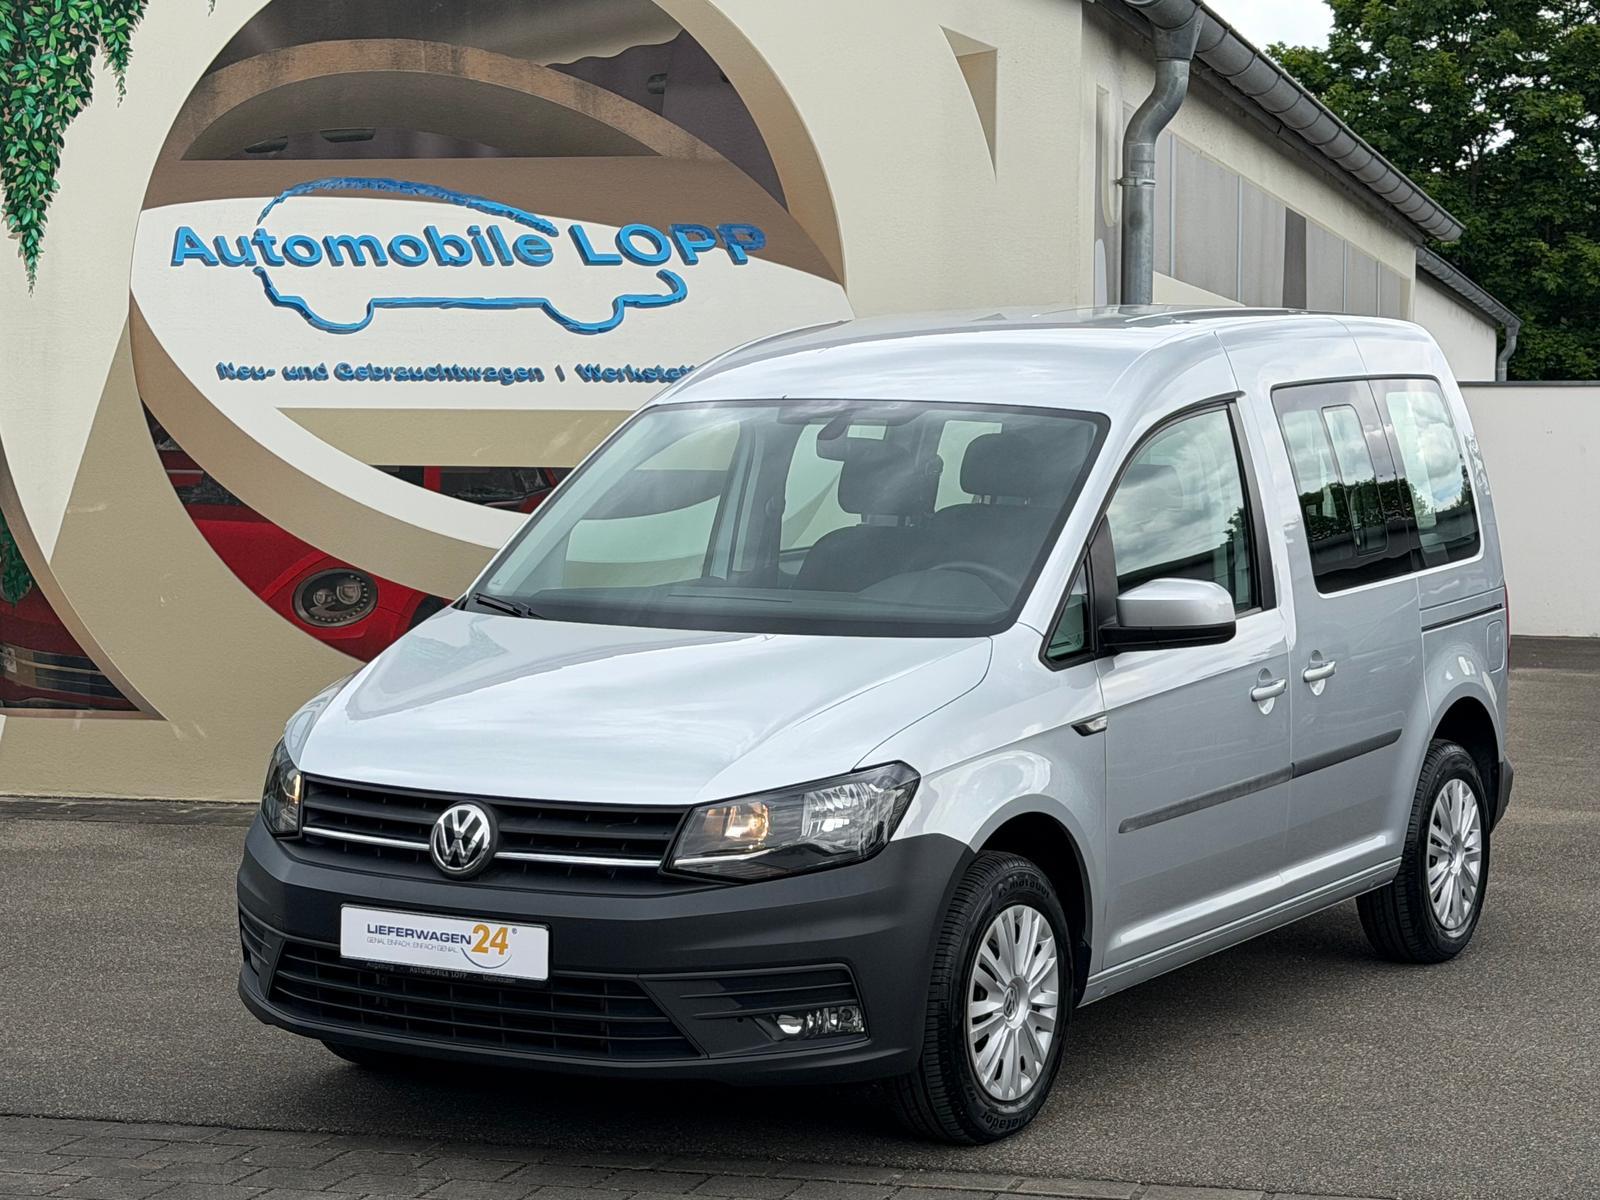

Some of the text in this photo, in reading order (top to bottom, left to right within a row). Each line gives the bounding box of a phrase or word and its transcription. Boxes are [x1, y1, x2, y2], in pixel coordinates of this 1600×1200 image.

[170, 223, 766, 267] Automobile LOPP
[216, 362, 276, 381] Neu-
[281, 362, 329, 381] und
[333, 362, 545, 386] Gebrauchtwagen
